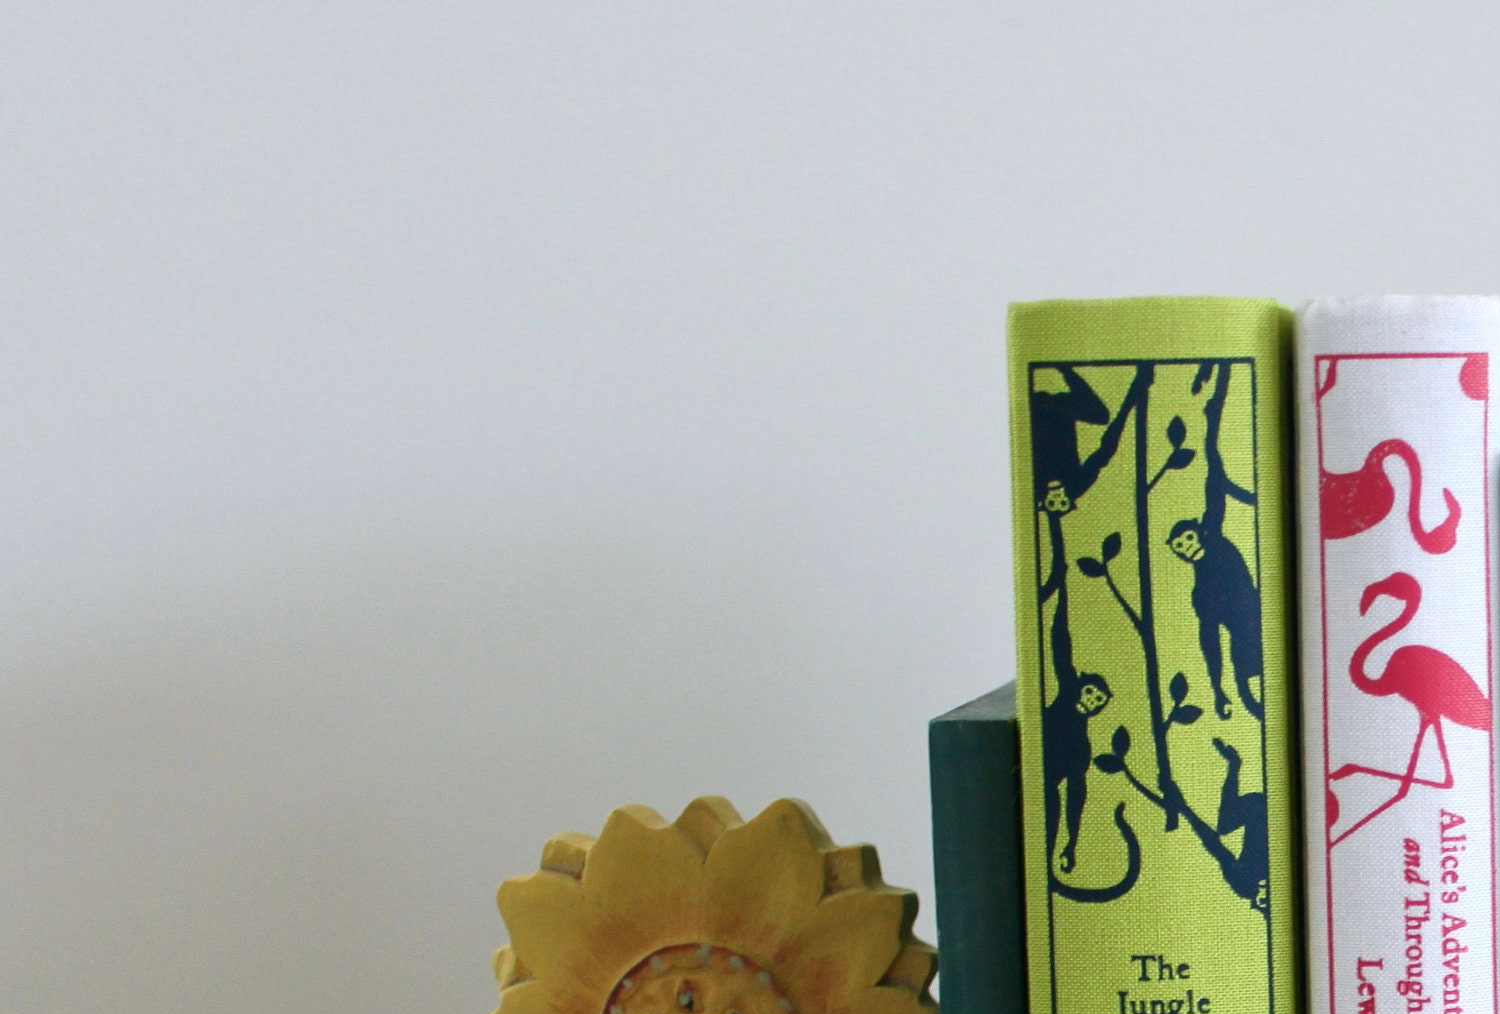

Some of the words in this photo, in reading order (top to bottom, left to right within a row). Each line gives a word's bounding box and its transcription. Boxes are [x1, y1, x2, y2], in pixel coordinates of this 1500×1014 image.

[1403, 837, 1430, 887] and
[1439, 808, 1467, 905] Alice's
[1131, 955, 1191, 982] The
[1396, 892, 1431, 1014] Through
